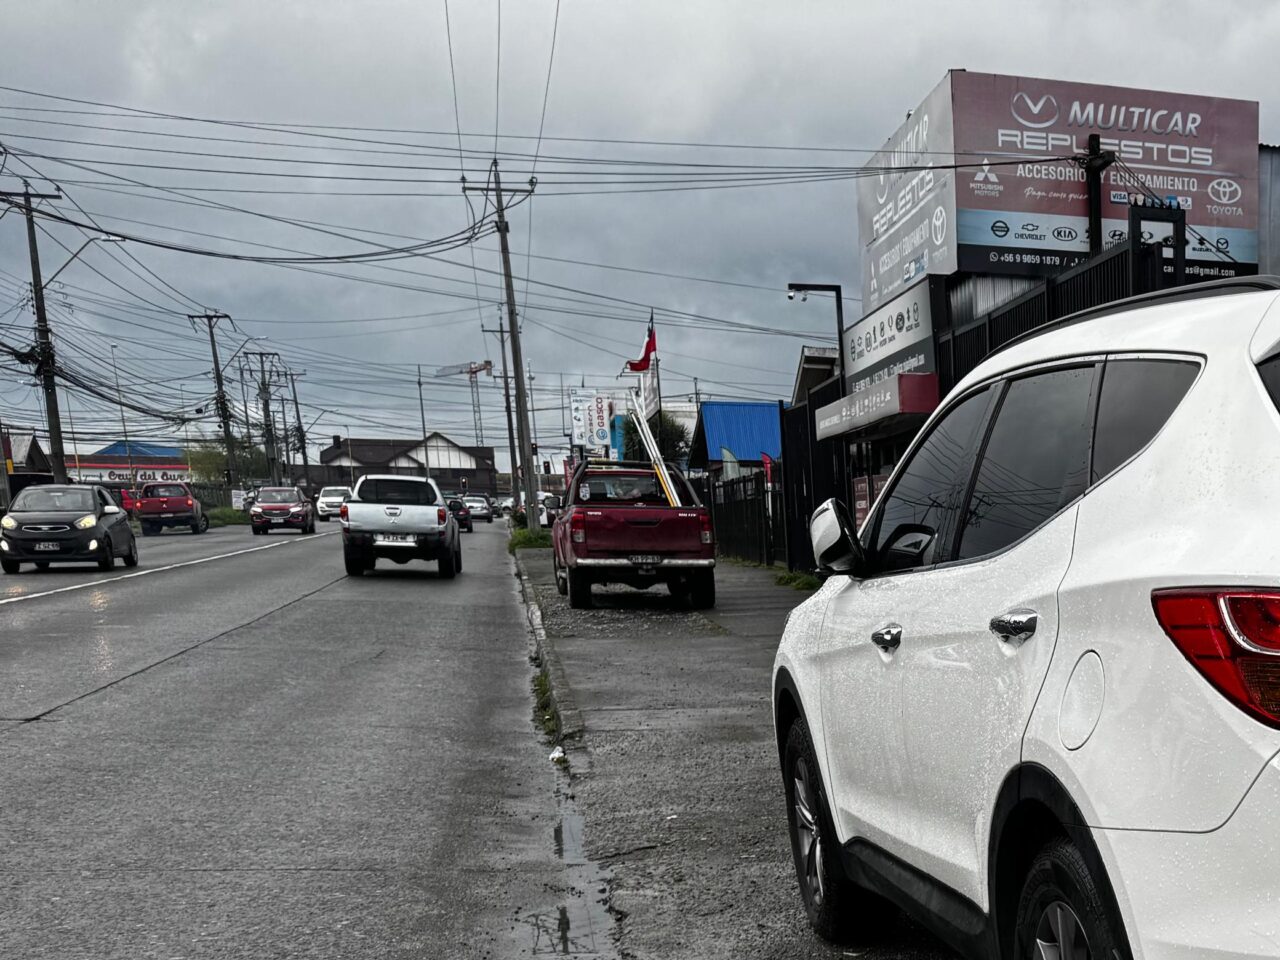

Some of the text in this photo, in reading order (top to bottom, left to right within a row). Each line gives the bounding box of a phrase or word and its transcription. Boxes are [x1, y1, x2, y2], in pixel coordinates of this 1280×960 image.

[1067, 100, 1202, 138] MULTICAR
[1016, 163, 1087, 183] ACCESORIO
[1110, 171, 1198, 192] EQUIPAMIENTO
[969, 182, 1004, 192] MITSUBISHI
[1112, 193, 1127, 201] VISA
[1206, 204, 1243, 216] TOYOTA
[1014, 232, 1047, 241] CHEVROLET
[1056, 229, 1075, 239] KIA
[1000, 253, 1013, 262] +56
[1015, 254, 1020, 262] 9
[1042, 255, 1060, 265] 1879
[140, 471, 158, 481] del
